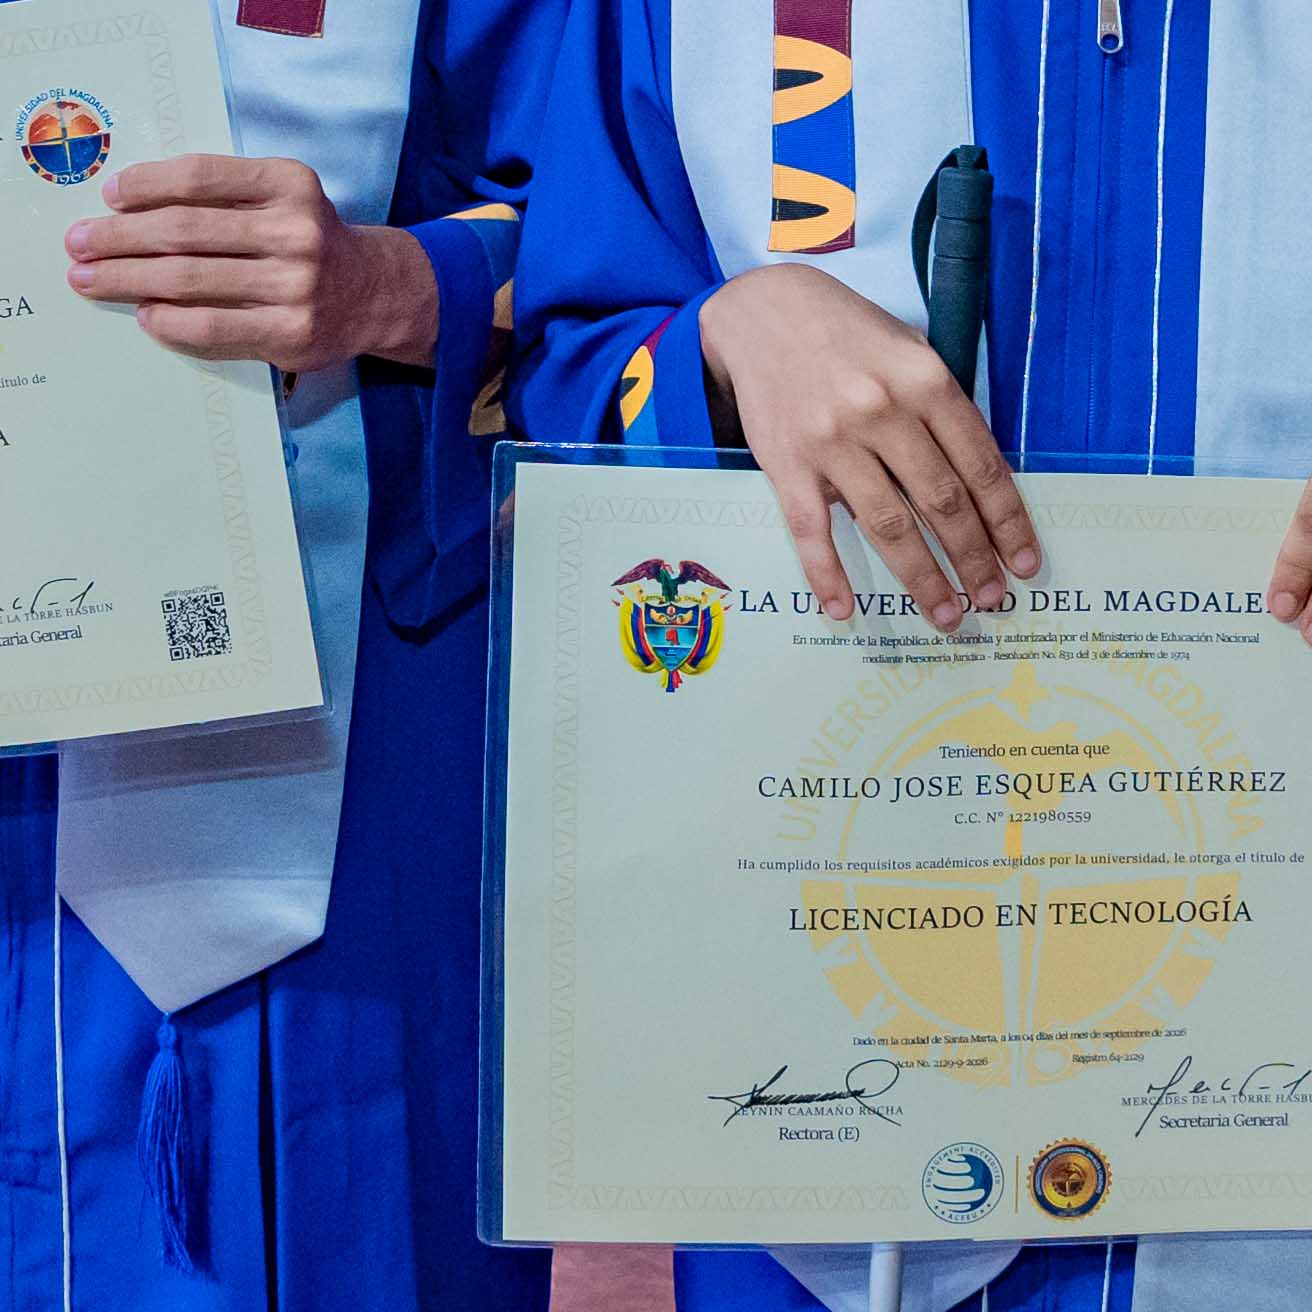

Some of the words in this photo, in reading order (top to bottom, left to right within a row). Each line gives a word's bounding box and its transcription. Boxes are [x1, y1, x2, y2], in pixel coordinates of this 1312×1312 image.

[31, 373, 46, 384] de
[739, 590, 779, 613] LA
[1029, 590, 1091, 612] DEL
[1102, 590, 1270, 614] MAGDALE
[6, 614, 21, 623] LA
[24, 607, 62, 622] TORRE
[30, 624, 83, 643] General
[792, 634, 807, 645] En
[809, 634, 851, 646] nombre
[852, 635, 865, 646] de
[867, 635, 877, 646] la
[879, 635, 930, 649] República
[930, 634, 944, 645] de
[945, 633, 994, 645] Colombia
[1003, 631, 1058, 643] autorizada
[1059, 634, 1078, 645] por
[1079, 631, 1088, 642] el
[1091, 631, 1144, 642] Ministerio
[1145, 631, 1158, 642] de
[1160, 631, 1213, 642] Educación
[1215, 632, 1259, 643] Nacional
[938, 743, 1005, 759] Teniendo
[1009, 746, 1027, 756] en
[1030, 743, 1079, 756] cuenta
[1083, 744, 1110, 758] que
[758, 776, 880, 798] CAMILO
[889, 775, 962, 803] JOSE
[975, 772, 1096, 800] ESQUEA
[1108, 765, 1285, 792] GUTIÉRREZ
[954, 812, 981, 824] C.C.
[1009, 809, 1091, 823] 1221980559
[738, 858, 755, 869] Ha
[759, 859, 820, 873] cumplido
[824, 859, 843, 870] los
[847, 859, 911, 873] requisitos
[915, 857, 989, 869] académicos
[992, 855, 1045, 868] exigidos
[1049, 856, 1069, 868] por
[1075, 853, 1086, 865] la
[1090, 852, 1170, 864] universidad,
[1174, 852, 1185, 863] le
[1189, 853, 1231, 865] otorga
[1234, 852, 1246, 863] el
[1289, 852, 1304, 863] de
[789, 905, 984, 931] LICENCIADO
[995, 903, 1037, 927] EN
[1048, 894, 1253, 925] TECNOLOGÍA
[1192, 1095, 1208, 1104] DE
[1212, 1095, 1227, 1104] LA
[1231, 1092, 1272, 1105] TORRE
[1159, 1113, 1230, 1129] Secretaria
[1233, 1112, 1288, 1127] General
[779, 1127, 834, 1140] Rectora
[837, 1126, 860, 1142] (E)
